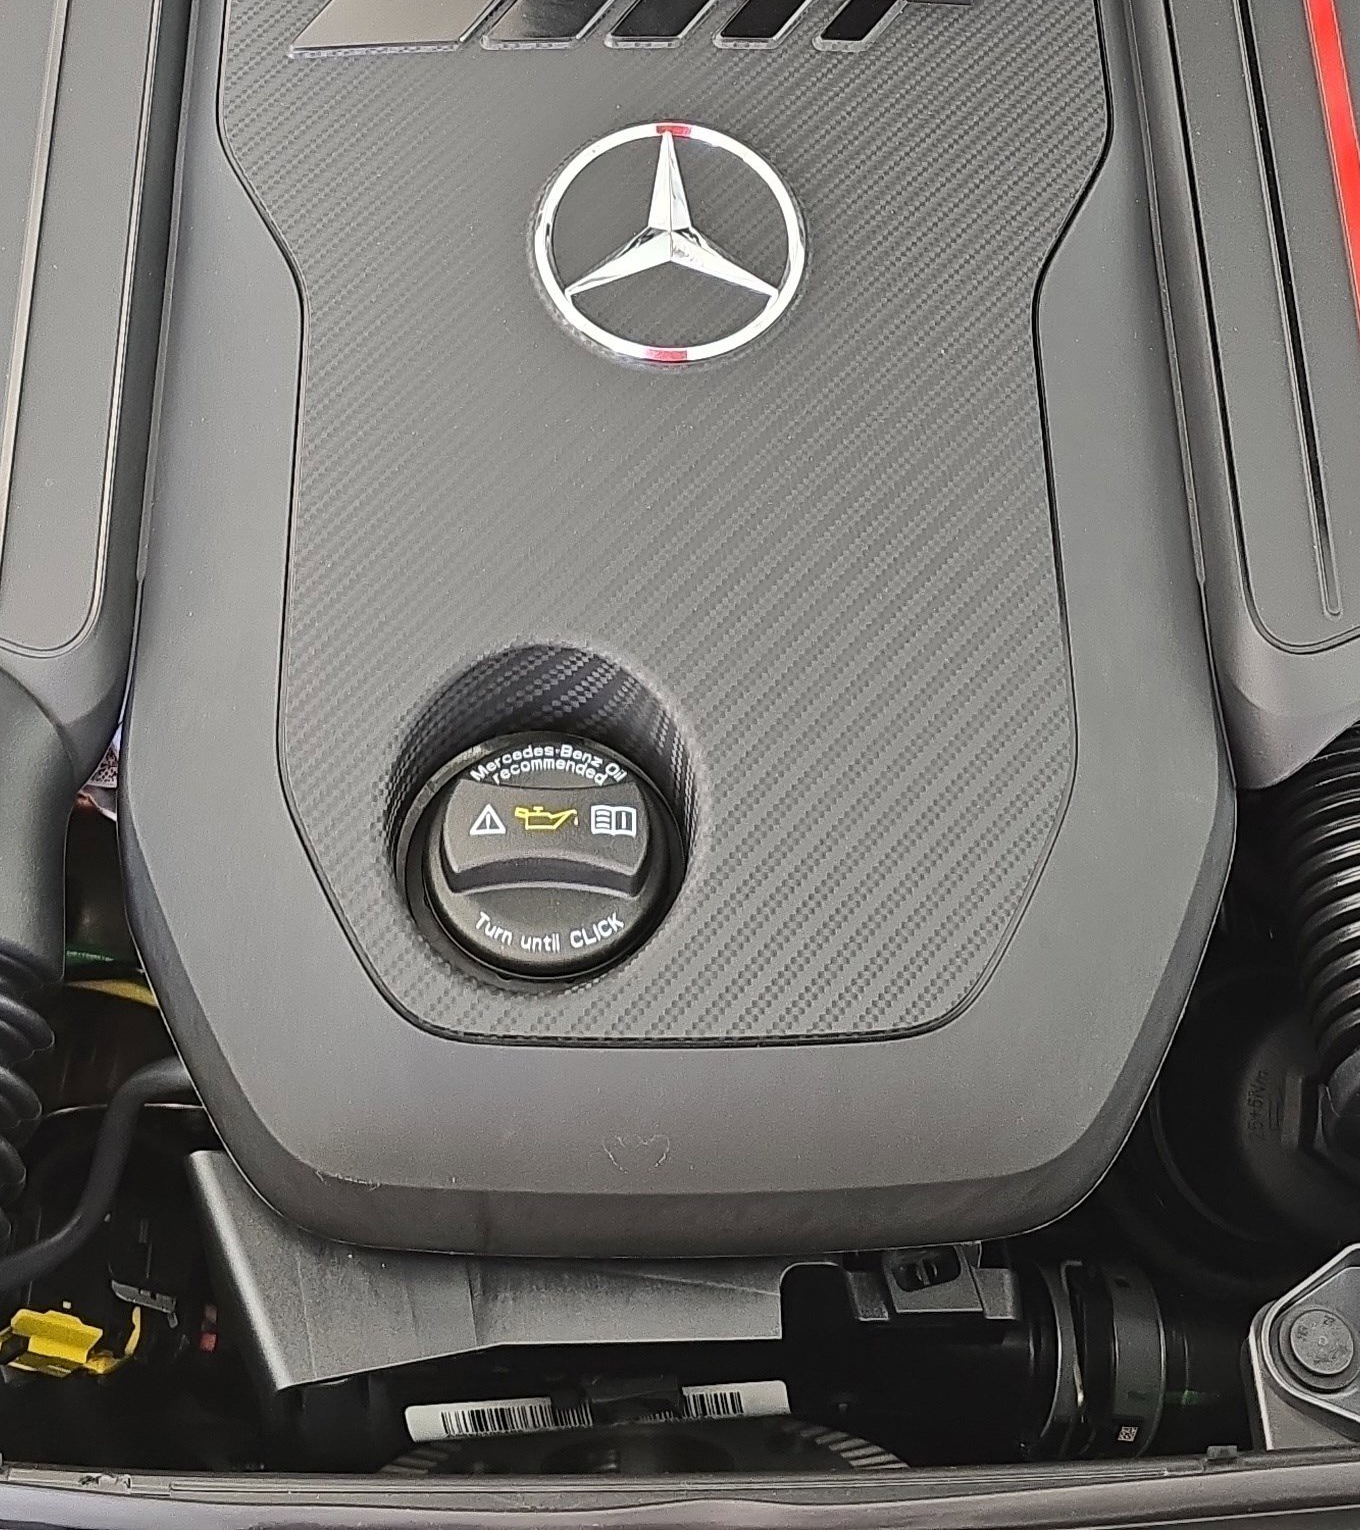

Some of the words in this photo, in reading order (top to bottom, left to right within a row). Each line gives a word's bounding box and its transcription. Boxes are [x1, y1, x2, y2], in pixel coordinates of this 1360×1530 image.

[469, 744, 604, 784] Mercedes-Benz
[603, 756, 628, 784] Oil
[492, 756, 609, 787] recommended
[474, 910, 514, 947] Turn
[521, 932, 561, 953] until
[569, 912, 625, 951] CLICK
